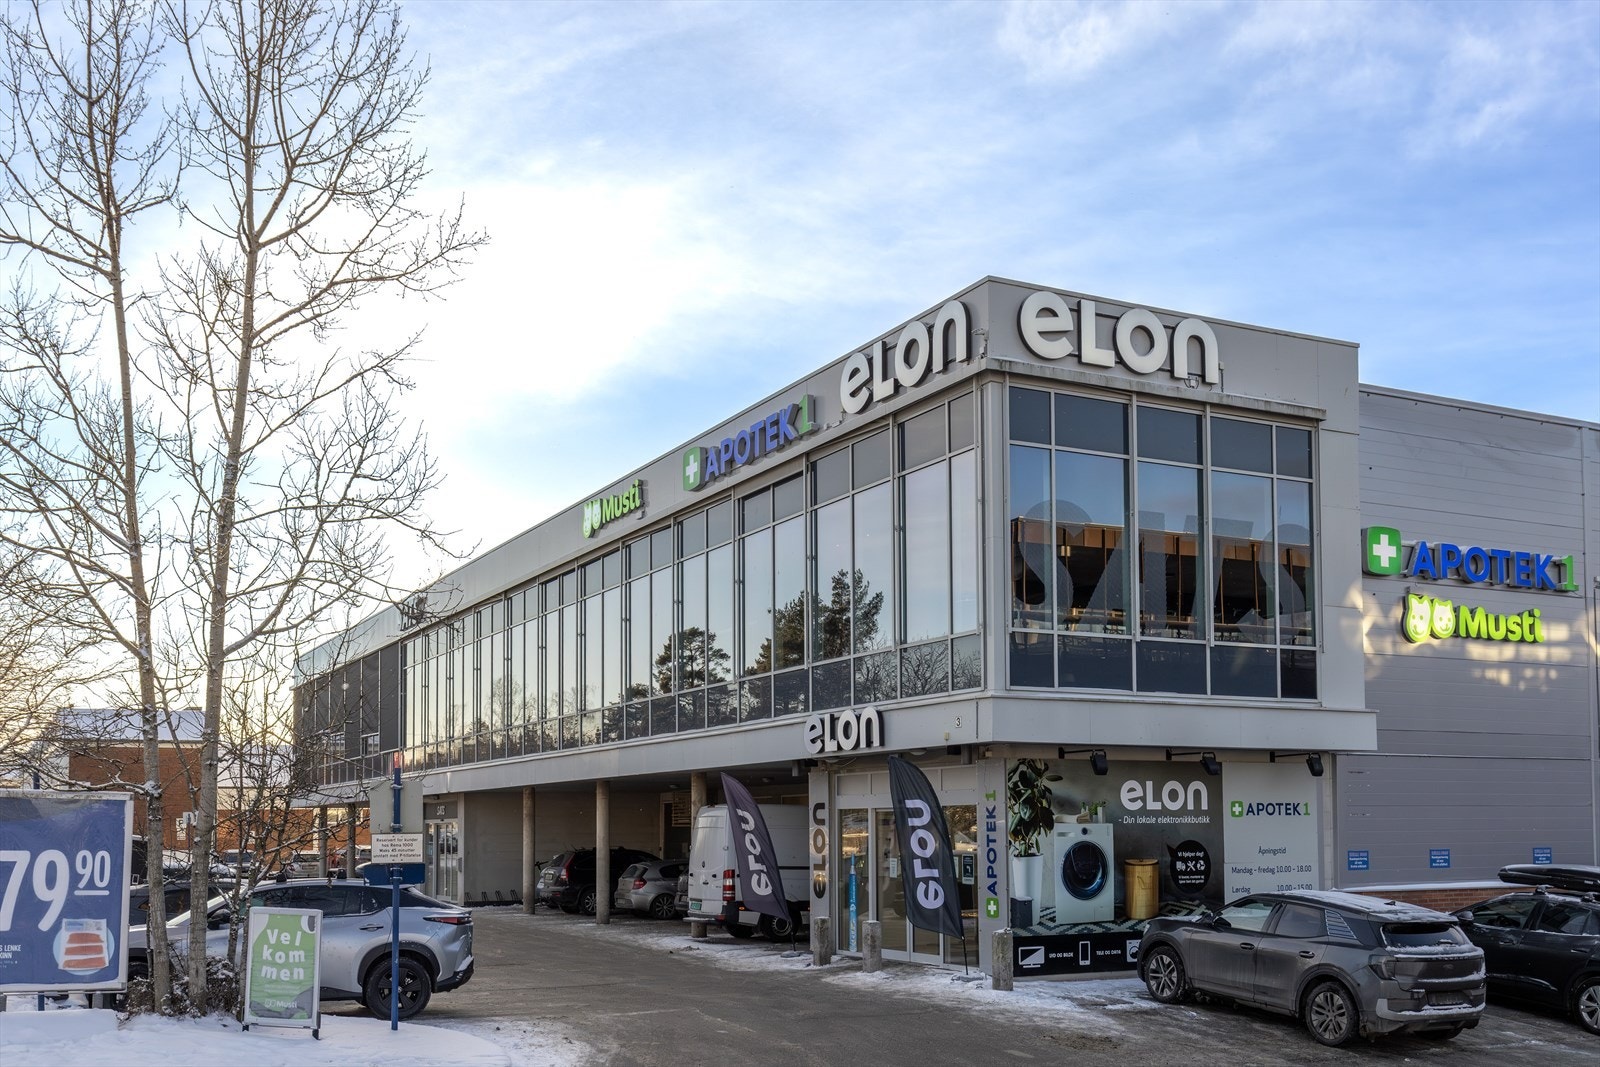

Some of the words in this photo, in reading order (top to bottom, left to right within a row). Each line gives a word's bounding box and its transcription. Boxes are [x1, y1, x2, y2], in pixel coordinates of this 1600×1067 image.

[704, 404, 797, 481] APOTEK
[602, 479, 642, 523] Musti
[1412, 541, 1556, 590] APOTEK
[1562, 555, 1579, 591] 1
[1459, 605, 1544, 643] Musti
[985, 790, 996, 801] 1
[1246, 803, 1301, 816] APOTEK
[1303, 802, 1310, 816] 1
[1123, 816, 1135, 824] Din
[1137, 816, 1156, 824] lokale
[1158, 816, 1210, 824] elektronikkbutikk
[986, 805, 998, 896] APOTEK
[1258, 846, 1286, 856] Åpningstid
[1231, 867, 1253, 875] Mandag
[1258, 866, 1275, 874] fredag
[1231, 886, 1250, 894] Lørdag
[262, 944, 305, 964] kom
[261, 965, 305, 981] men
